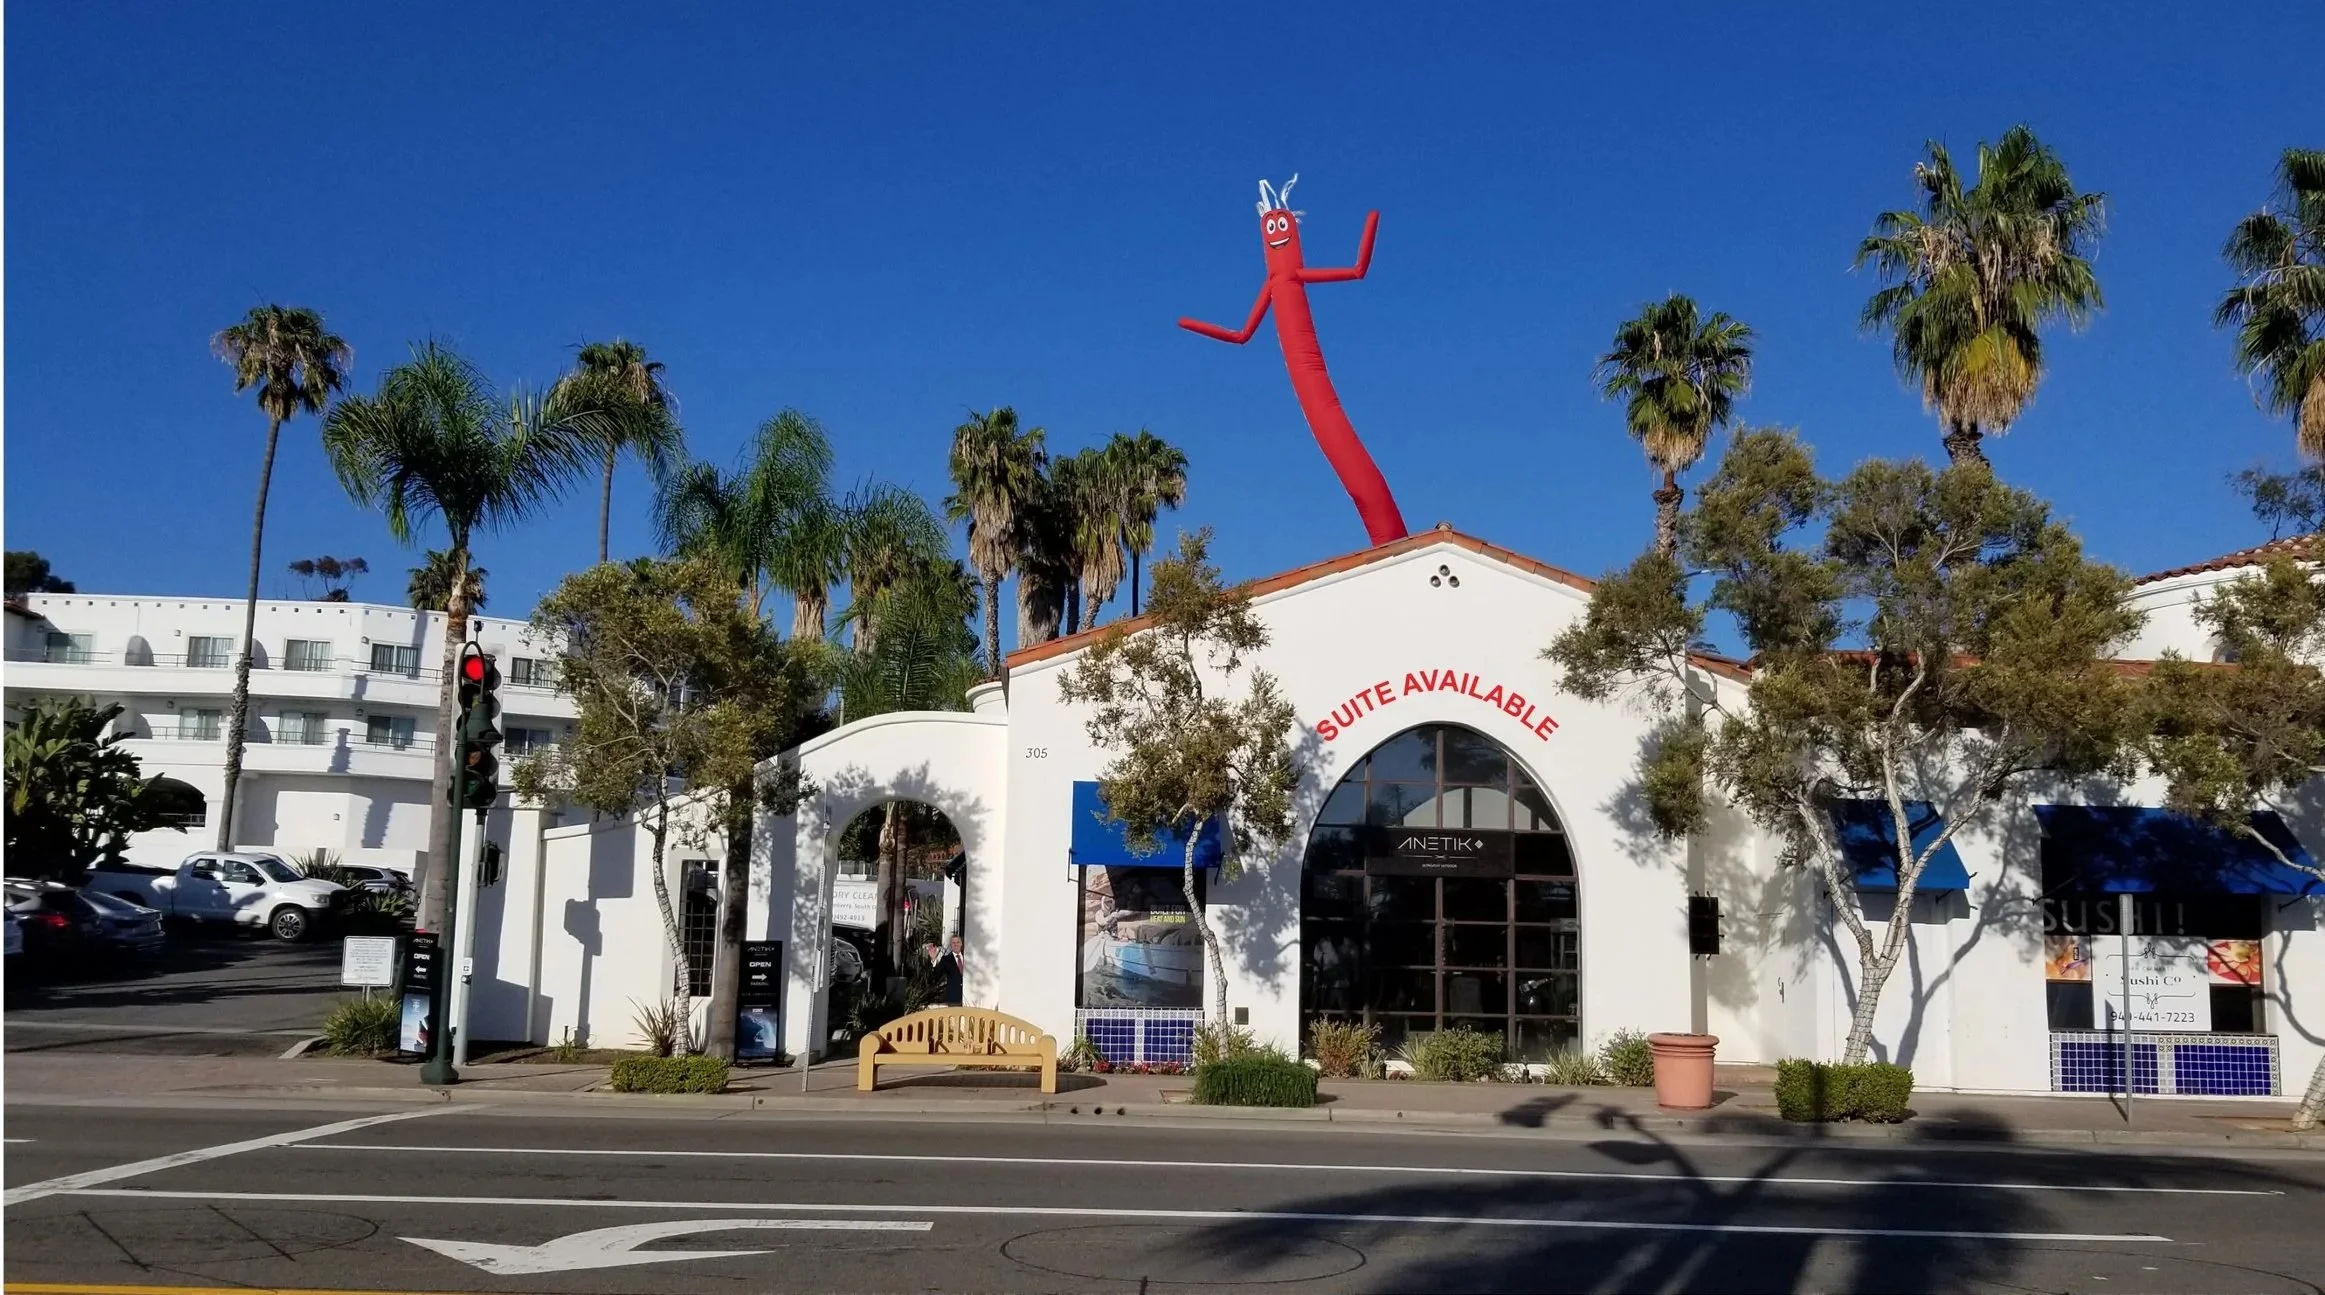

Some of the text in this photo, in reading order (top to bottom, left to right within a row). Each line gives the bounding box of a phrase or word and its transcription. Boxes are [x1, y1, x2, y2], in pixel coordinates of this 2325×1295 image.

[1316, 669, 1560, 742] SUITE AVAILABLE
[1025, 747, 1048, 759] 305
[1398, 836, 1473, 851] ANETIK
